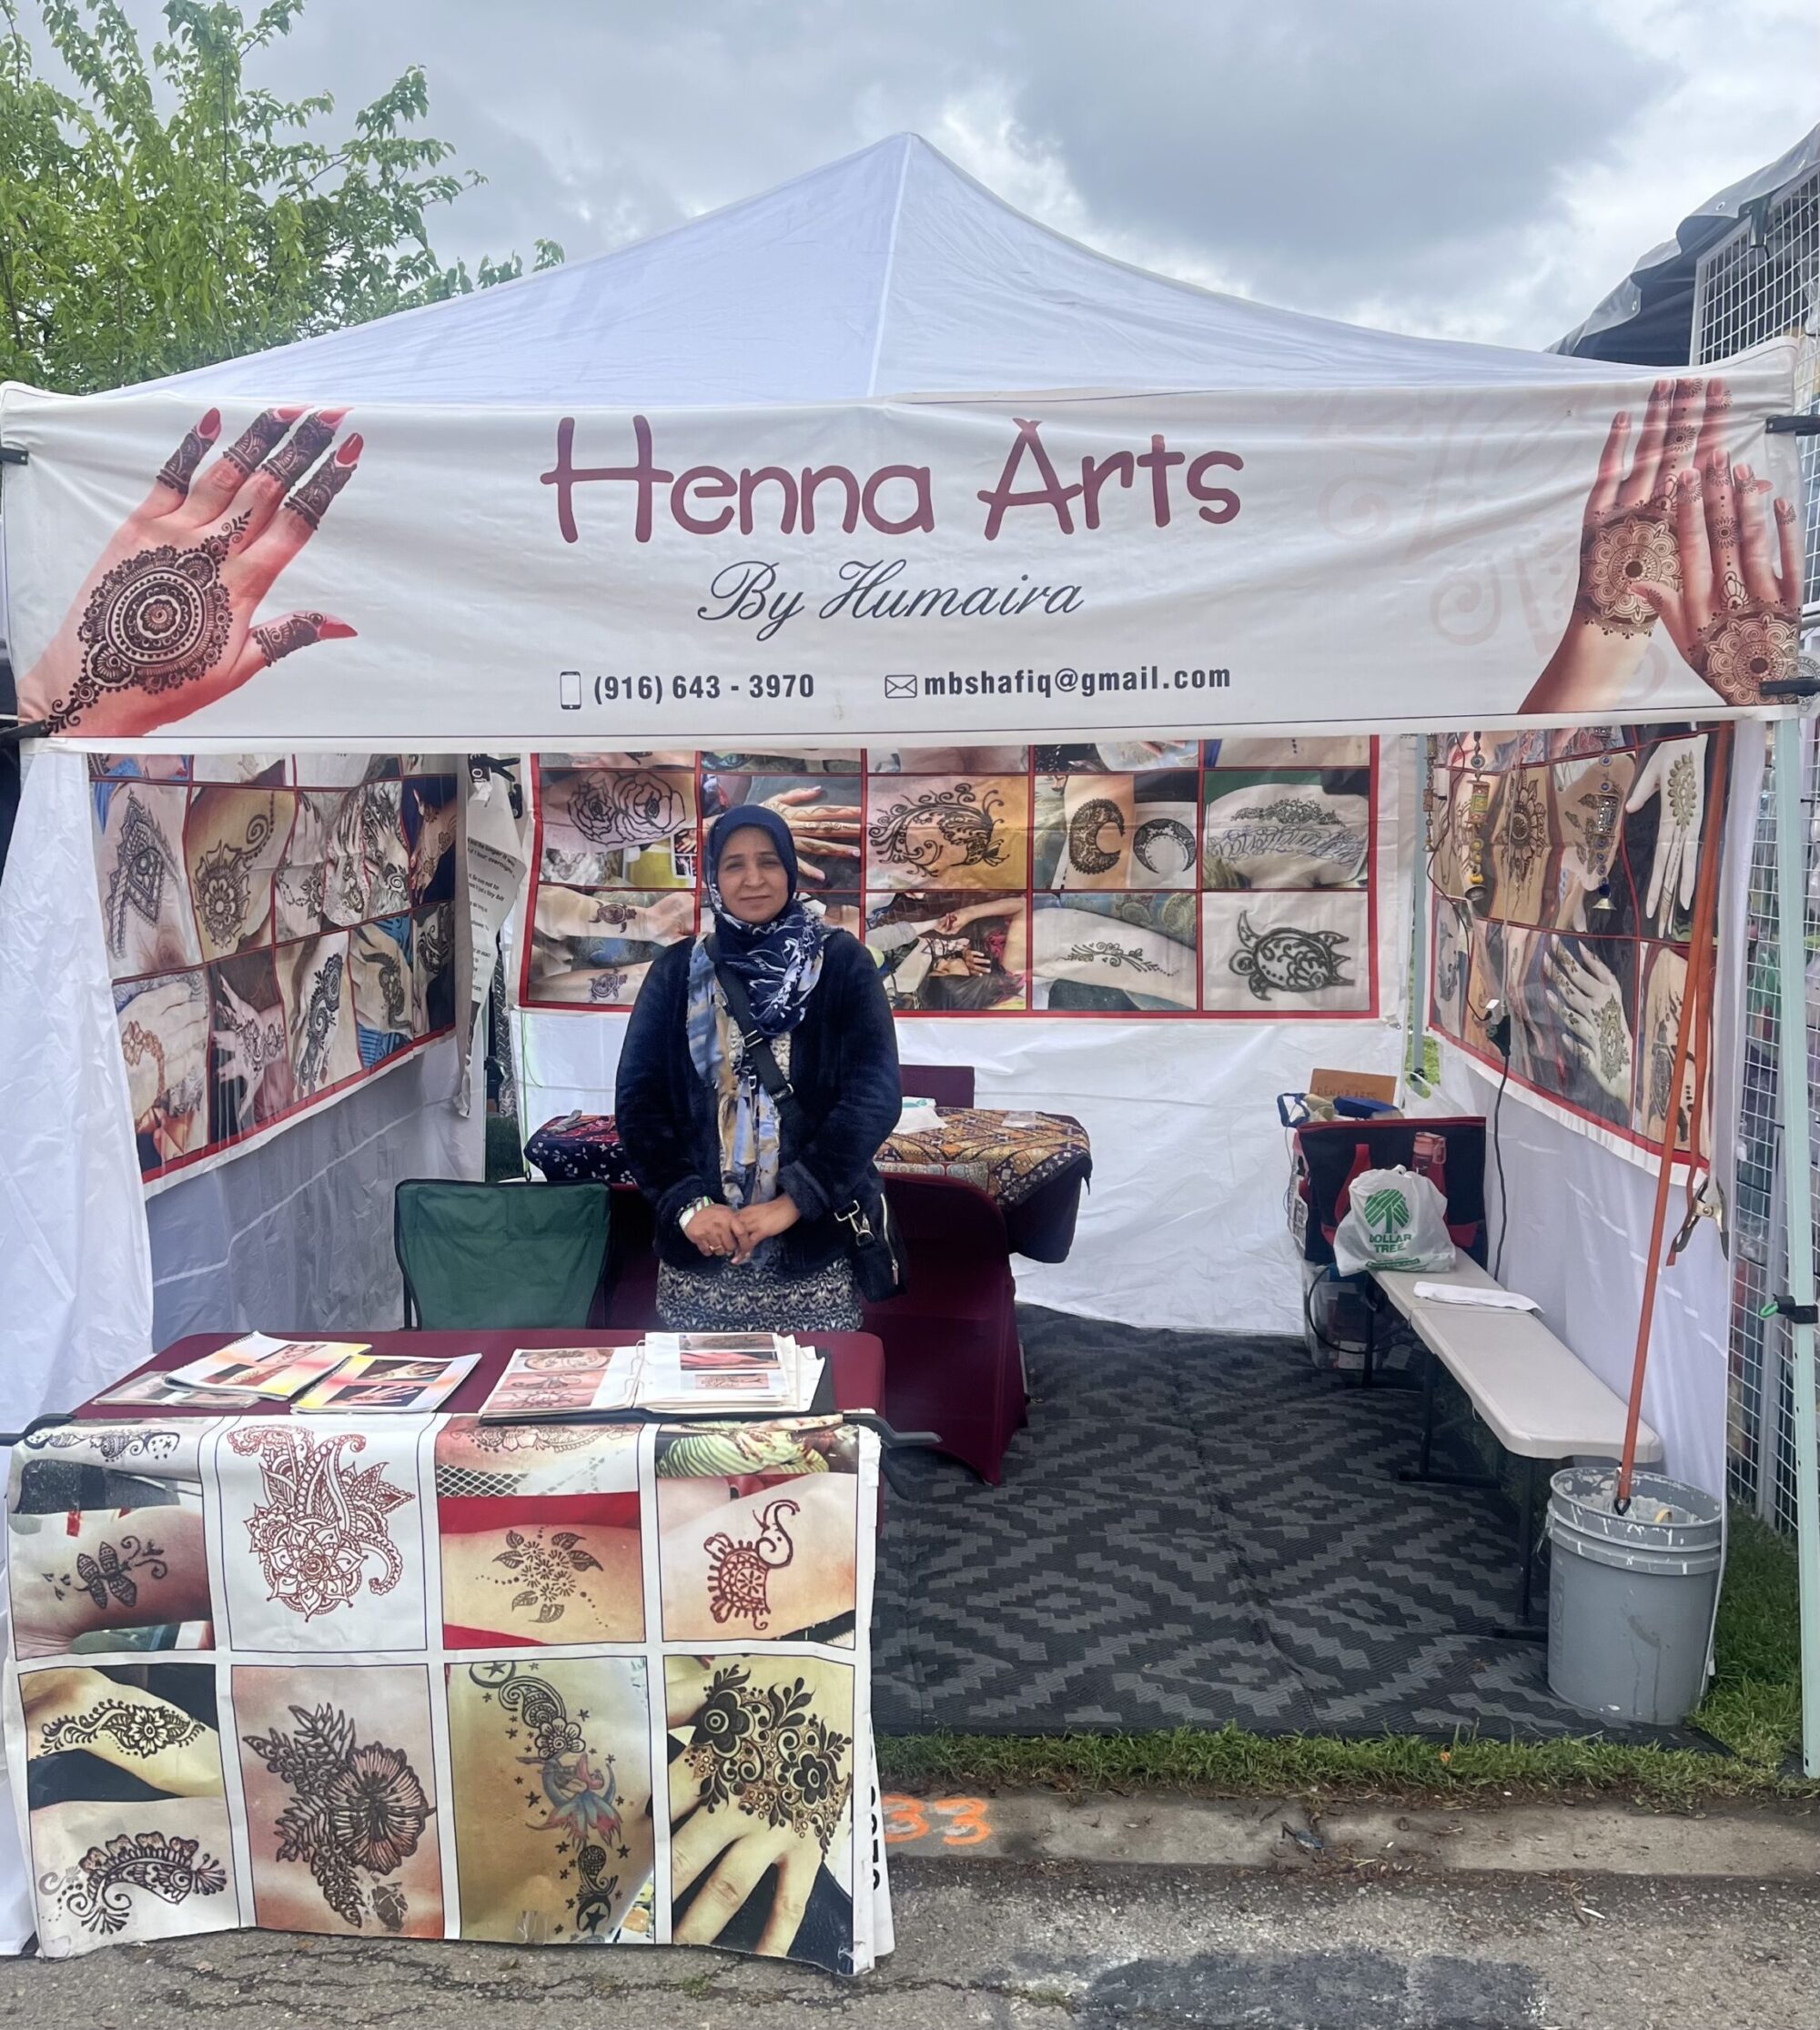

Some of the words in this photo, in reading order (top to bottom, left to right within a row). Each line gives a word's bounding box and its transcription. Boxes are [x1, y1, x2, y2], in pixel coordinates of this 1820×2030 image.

[540, 414, 935, 543] Henna
[976, 417, 1244, 540] Arts
[697, 561, 804, 641] By
[819, 559, 1085, 620] Humaira
[593, 675, 663, 705] (916)
[672, 674, 721, 700] 643
[748, 673, 814, 699] 3970
[924, 666, 1230, 699] mbshafiq@gmail.com
[1370, 1234, 1411, 1243] DOLLAR
[1374, 1243, 1406, 1253] TREE
